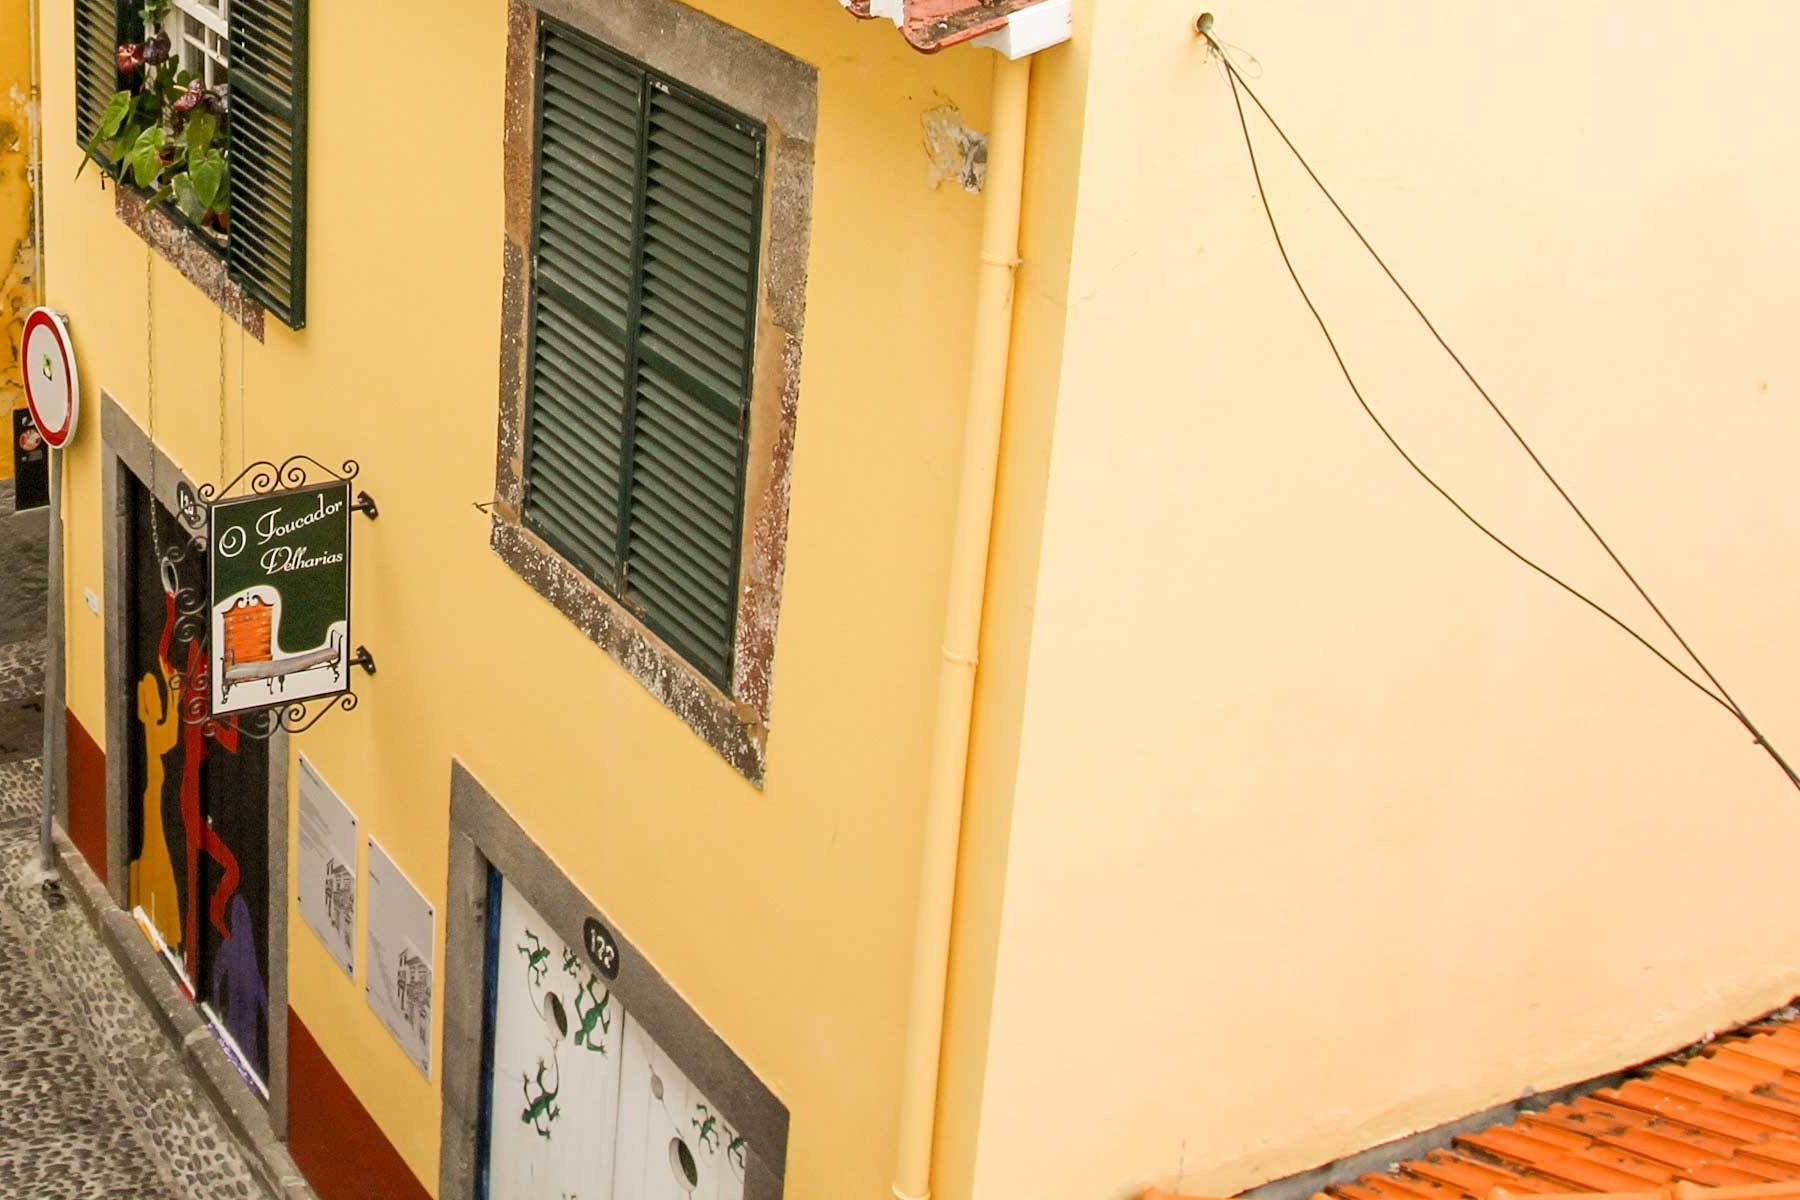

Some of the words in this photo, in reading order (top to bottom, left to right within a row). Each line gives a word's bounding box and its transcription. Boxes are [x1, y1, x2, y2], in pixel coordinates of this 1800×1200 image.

[219, 525, 247, 558] O
[256, 493, 343, 545] Toucador
[260, 546, 343, 575] Velharias
[590, 928, 615, 969] 122
